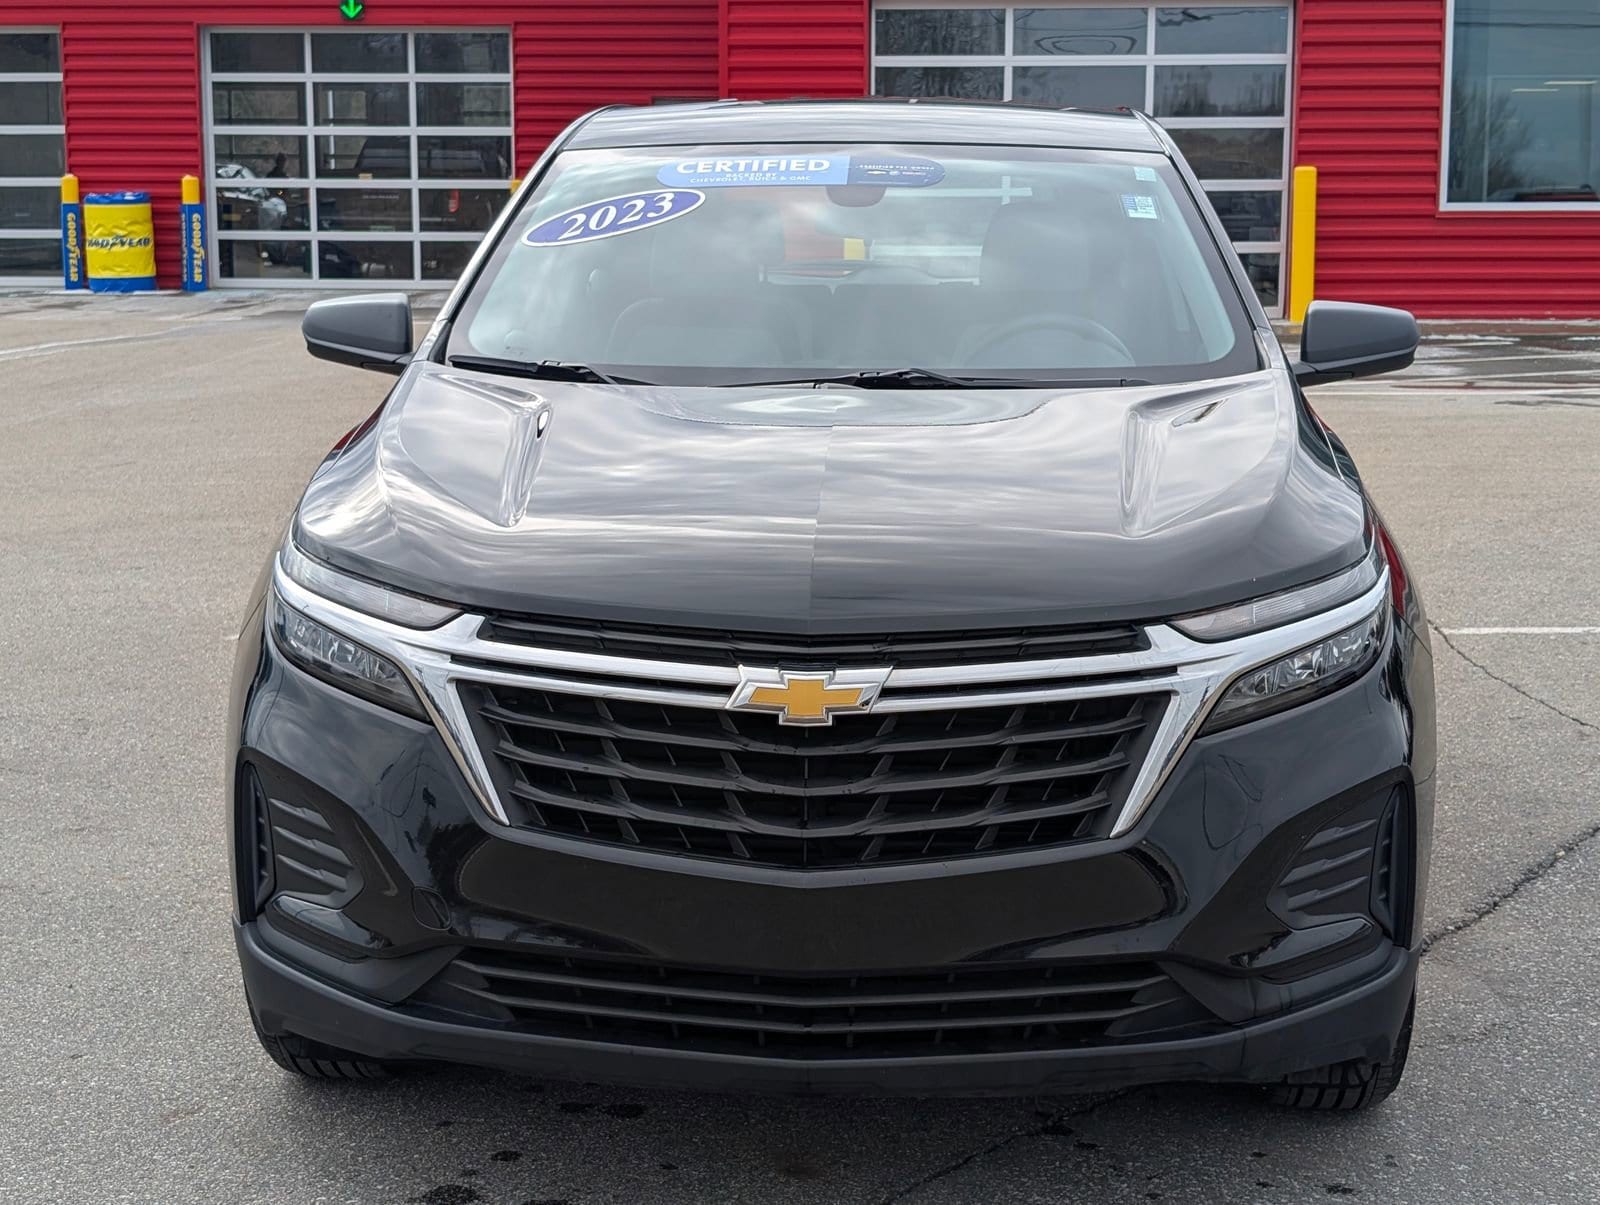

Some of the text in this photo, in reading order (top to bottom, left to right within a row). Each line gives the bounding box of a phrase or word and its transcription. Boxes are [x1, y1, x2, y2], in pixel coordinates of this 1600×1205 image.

[676, 159, 831, 174] CERTIFIED
[557, 192, 675, 240] 2023
[66, 212, 80, 282] GOODYEAR
[191, 212, 205, 283] GOODYEAR
